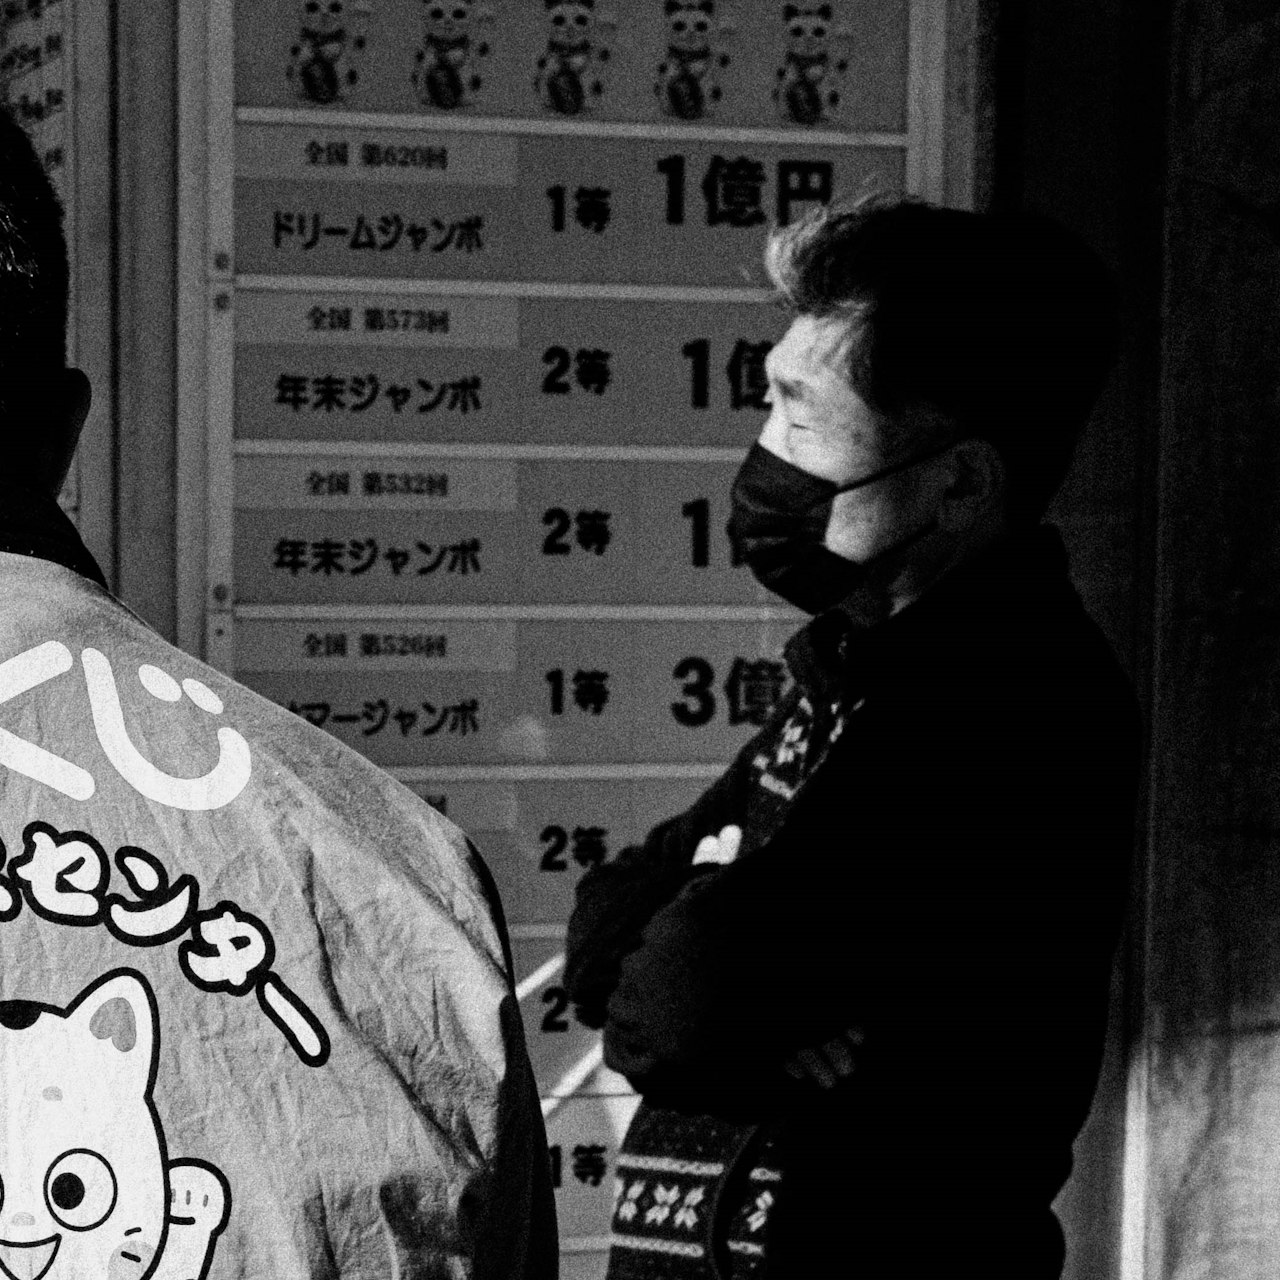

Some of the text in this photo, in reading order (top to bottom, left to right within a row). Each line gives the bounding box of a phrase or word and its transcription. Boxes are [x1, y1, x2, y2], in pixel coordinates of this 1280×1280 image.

[547, 186, 610, 232] 1等
[657, 155, 833, 227] 1億円
[273, 212, 483, 252] ドリームジャンボ
[276, 374, 482, 413] 年末ジャンボ
[542, 346, 610, 395] 2等
[542, 508, 610, 555] 2等
[275, 538, 480, 575] 年末ジャンボ
[546, 668, 609, 715] 1等
[289, 700, 480, 737] マージャンボ
[540, 825, 607, 871] 2等
